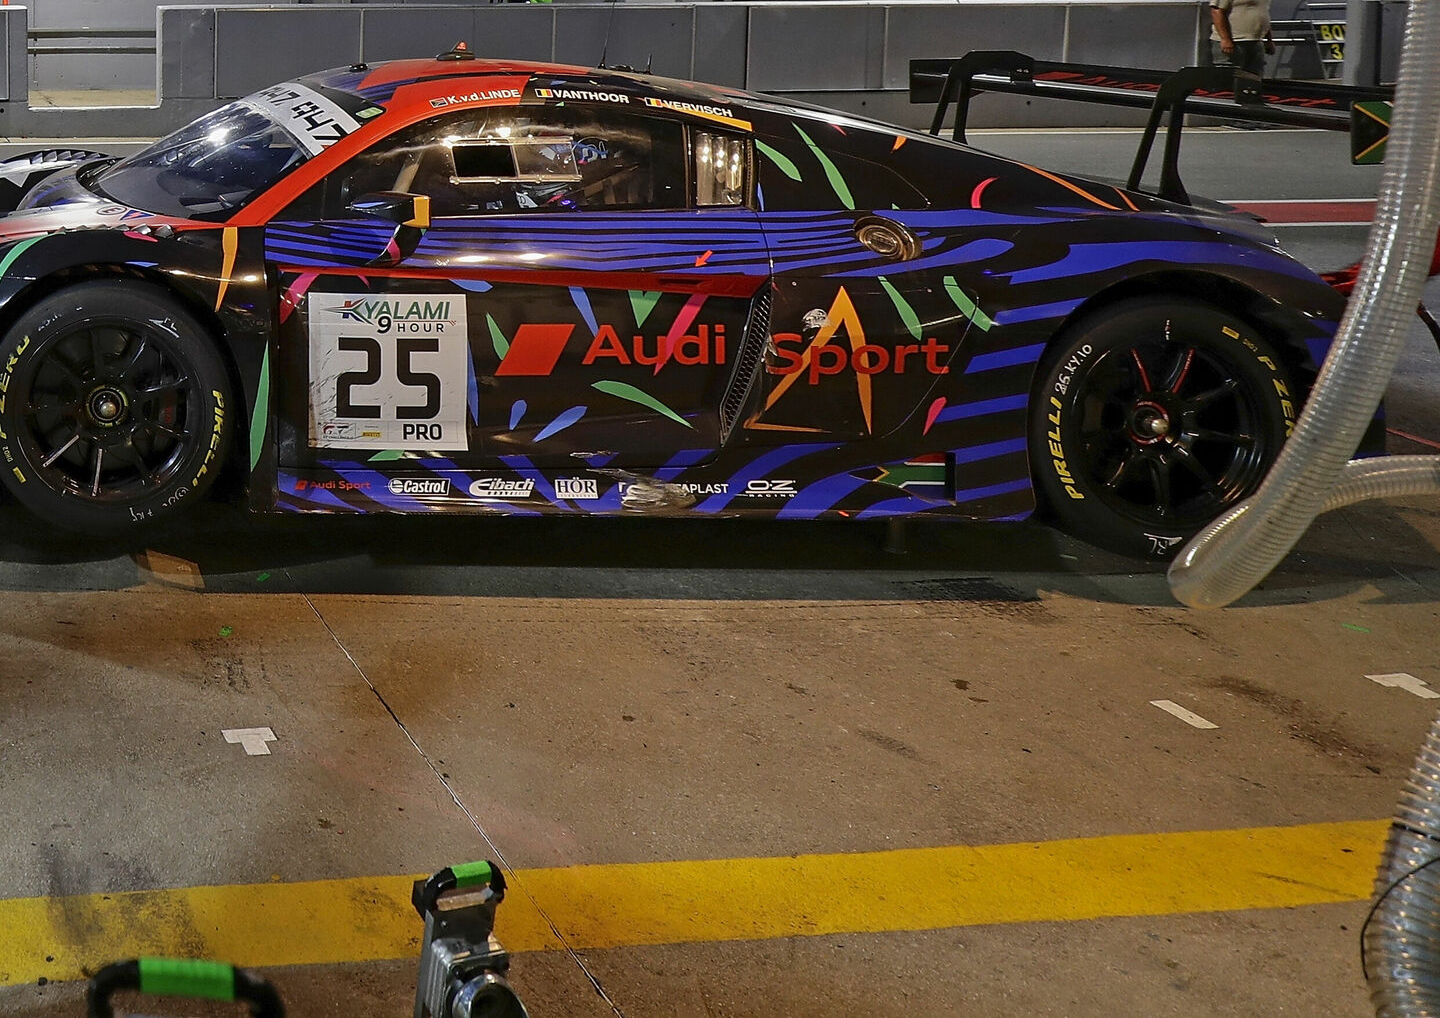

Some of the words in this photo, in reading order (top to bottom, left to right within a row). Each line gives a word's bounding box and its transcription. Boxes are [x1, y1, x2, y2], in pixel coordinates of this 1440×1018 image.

[1321, 25, 1346, 41] BO
[552, 89, 630, 104] VANTHOOR
[662, 99, 733, 118] VERVISCH
[332, 297, 451, 325] KYALAMI
[377, 315, 392, 333] 9
[397, 323, 444, 333] HOUR
[582, 324, 726, 366] Audi
[767, 332, 950, 384] Sport
[336, 337, 441, 419] 25
[1257, 355, 1277, 372] P
[1272, 378, 1296, 439] ZER
[403, 423, 442, 441] PRO
[1047, 397, 1085, 500] PIRELLI
[310, 481, 336, 490] Audi
[338, 481, 371, 492] Sport
[403, 480, 446, 494] Castrol
[469, 478, 535, 497] Eibach
[556, 477, 596, 493] HÖR
